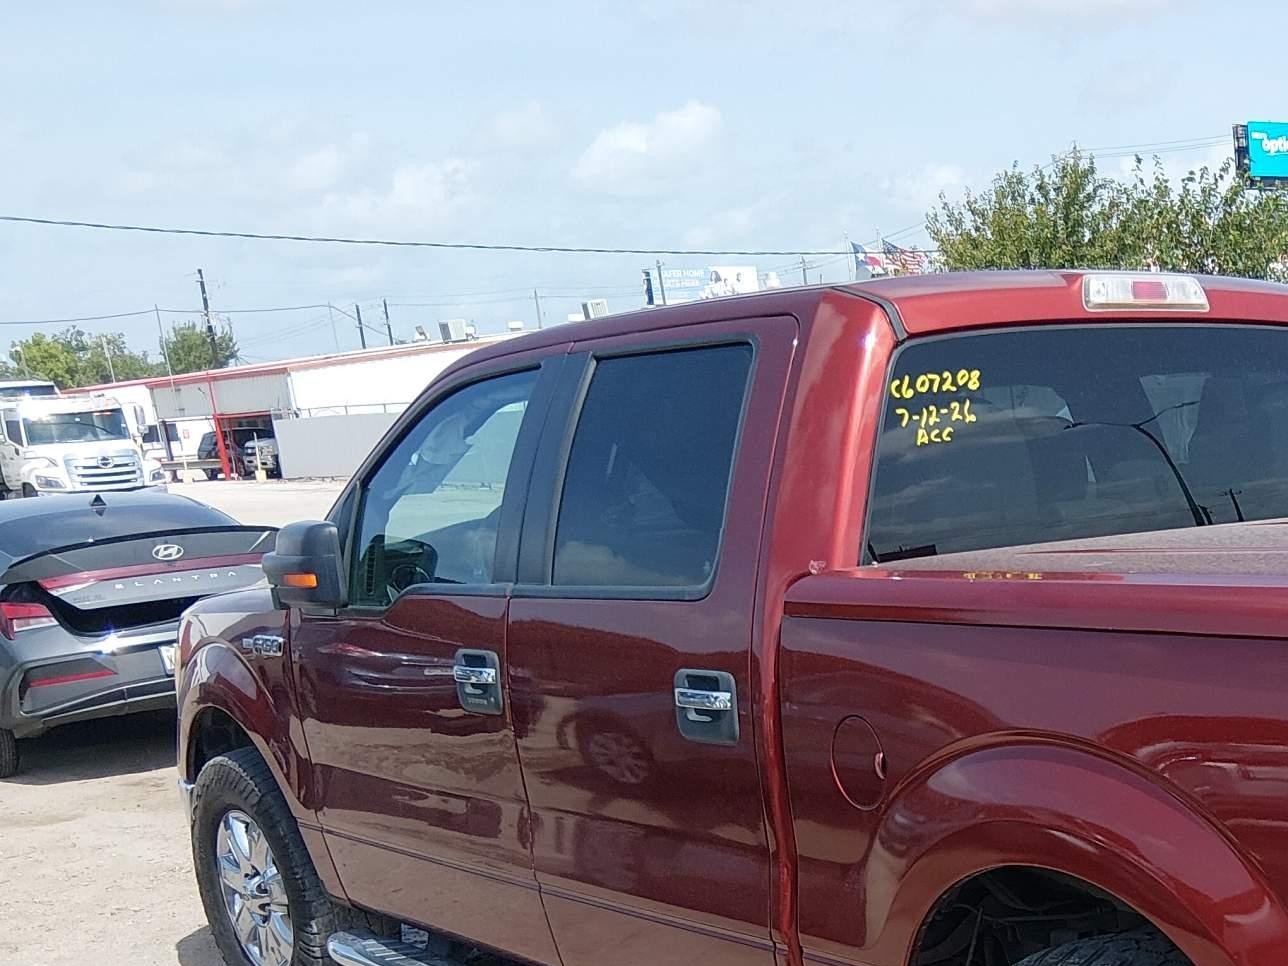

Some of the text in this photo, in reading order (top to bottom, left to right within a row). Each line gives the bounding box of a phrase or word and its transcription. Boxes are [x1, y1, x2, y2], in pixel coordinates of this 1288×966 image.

[890, 369, 981, 399] C607208
[895, 398, 977, 428] 7-12-26
[916, 426, 954, 446] ACC
[114, 570, 237, 590] ELANTRA
